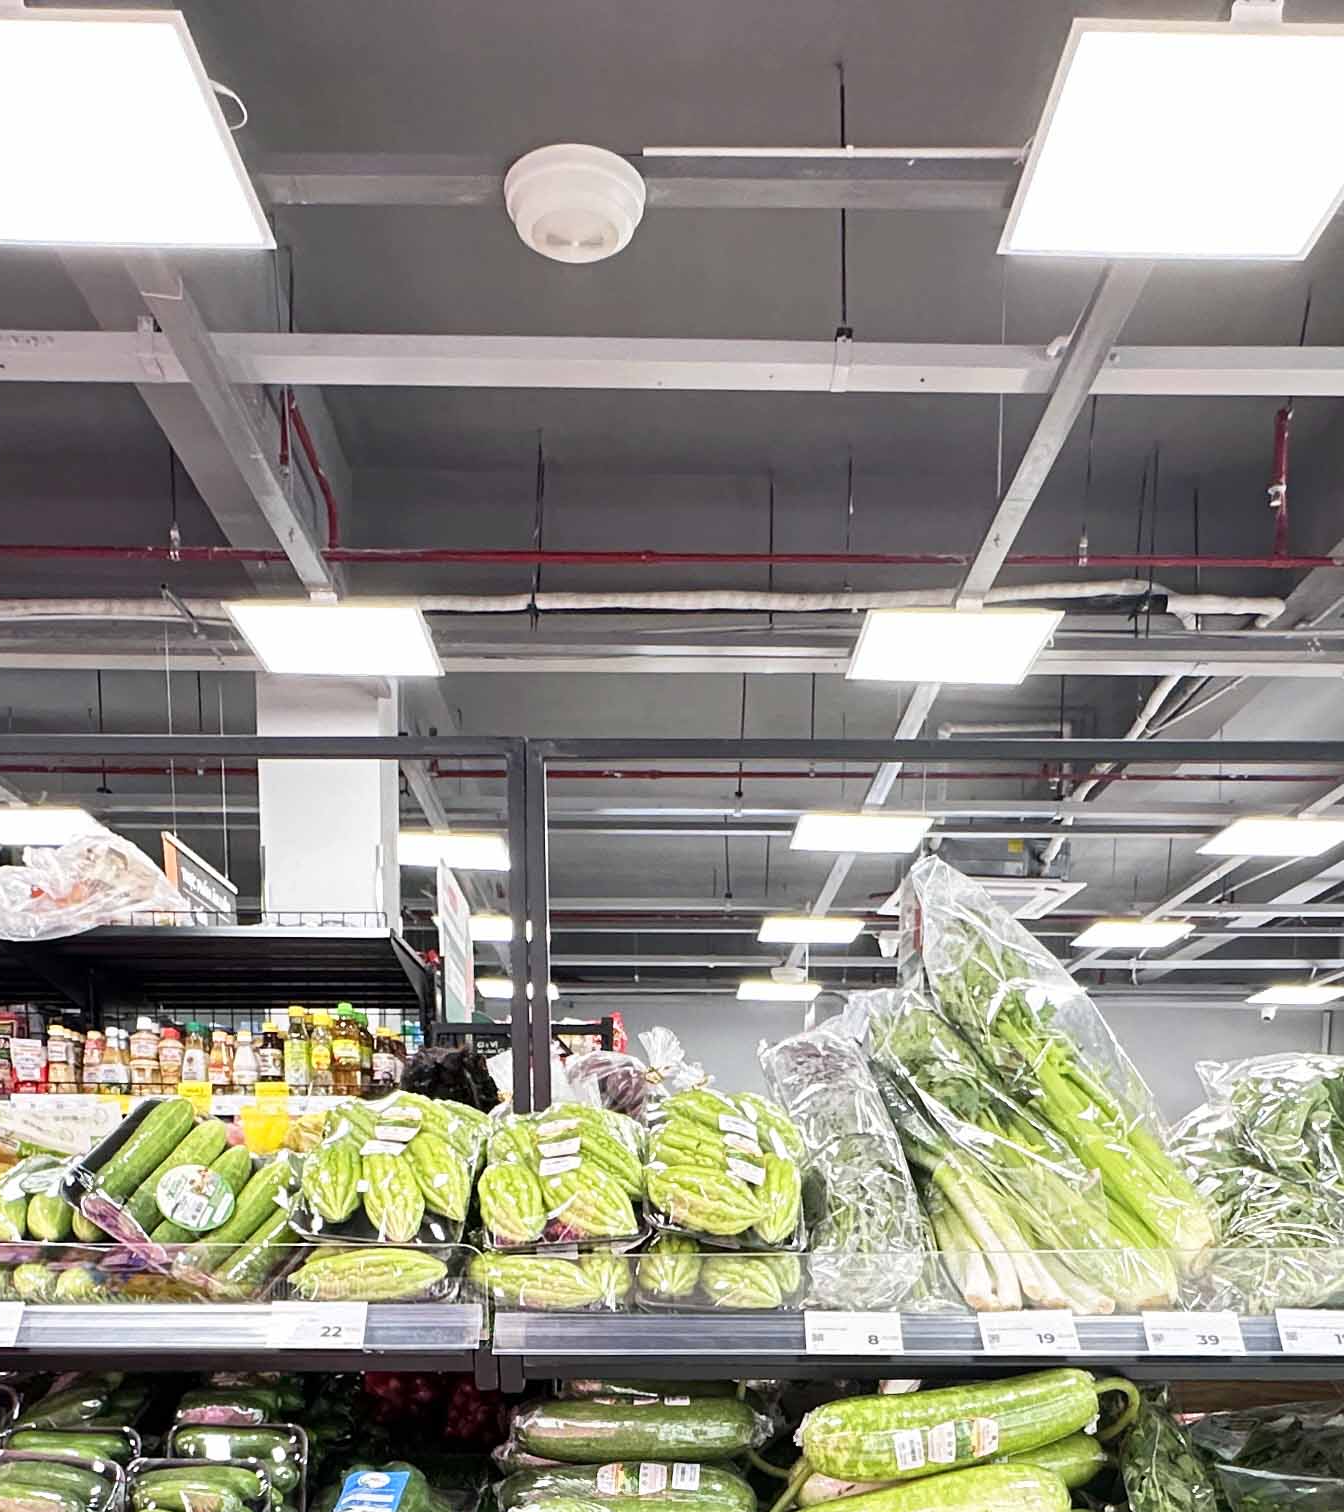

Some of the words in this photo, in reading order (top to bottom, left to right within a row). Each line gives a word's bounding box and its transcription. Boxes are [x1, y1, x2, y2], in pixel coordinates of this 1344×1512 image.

[319, 1325, 342, 1338] 22
[867, 1334, 880, 1345] 8
[1036, 1332, 1056, 1344] 19
[1196, 1334, 1220, 1346] 39
